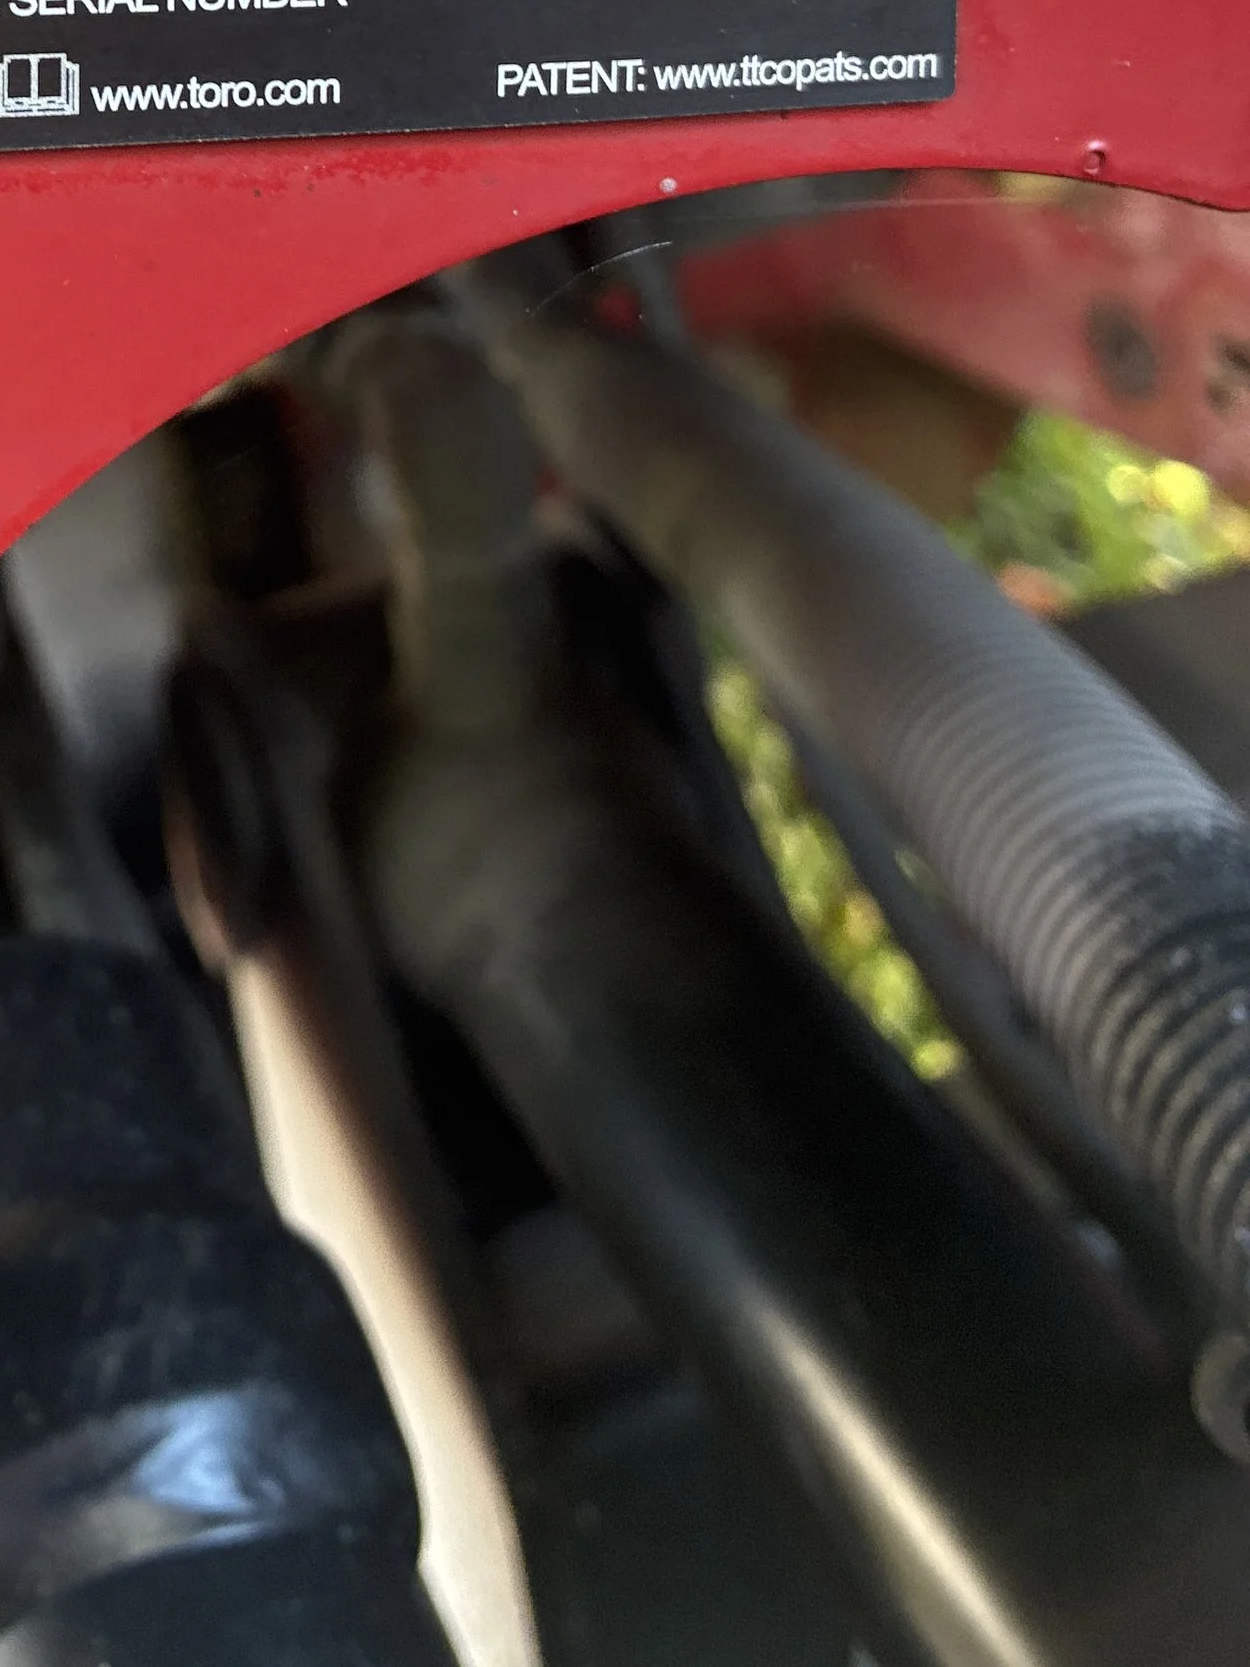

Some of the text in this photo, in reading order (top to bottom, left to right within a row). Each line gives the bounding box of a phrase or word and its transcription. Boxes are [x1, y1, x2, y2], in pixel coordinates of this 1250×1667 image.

[90, 76, 341, 112] www.toro.com
[497, 50, 939, 98] PATENT: www.ttcopats.com
